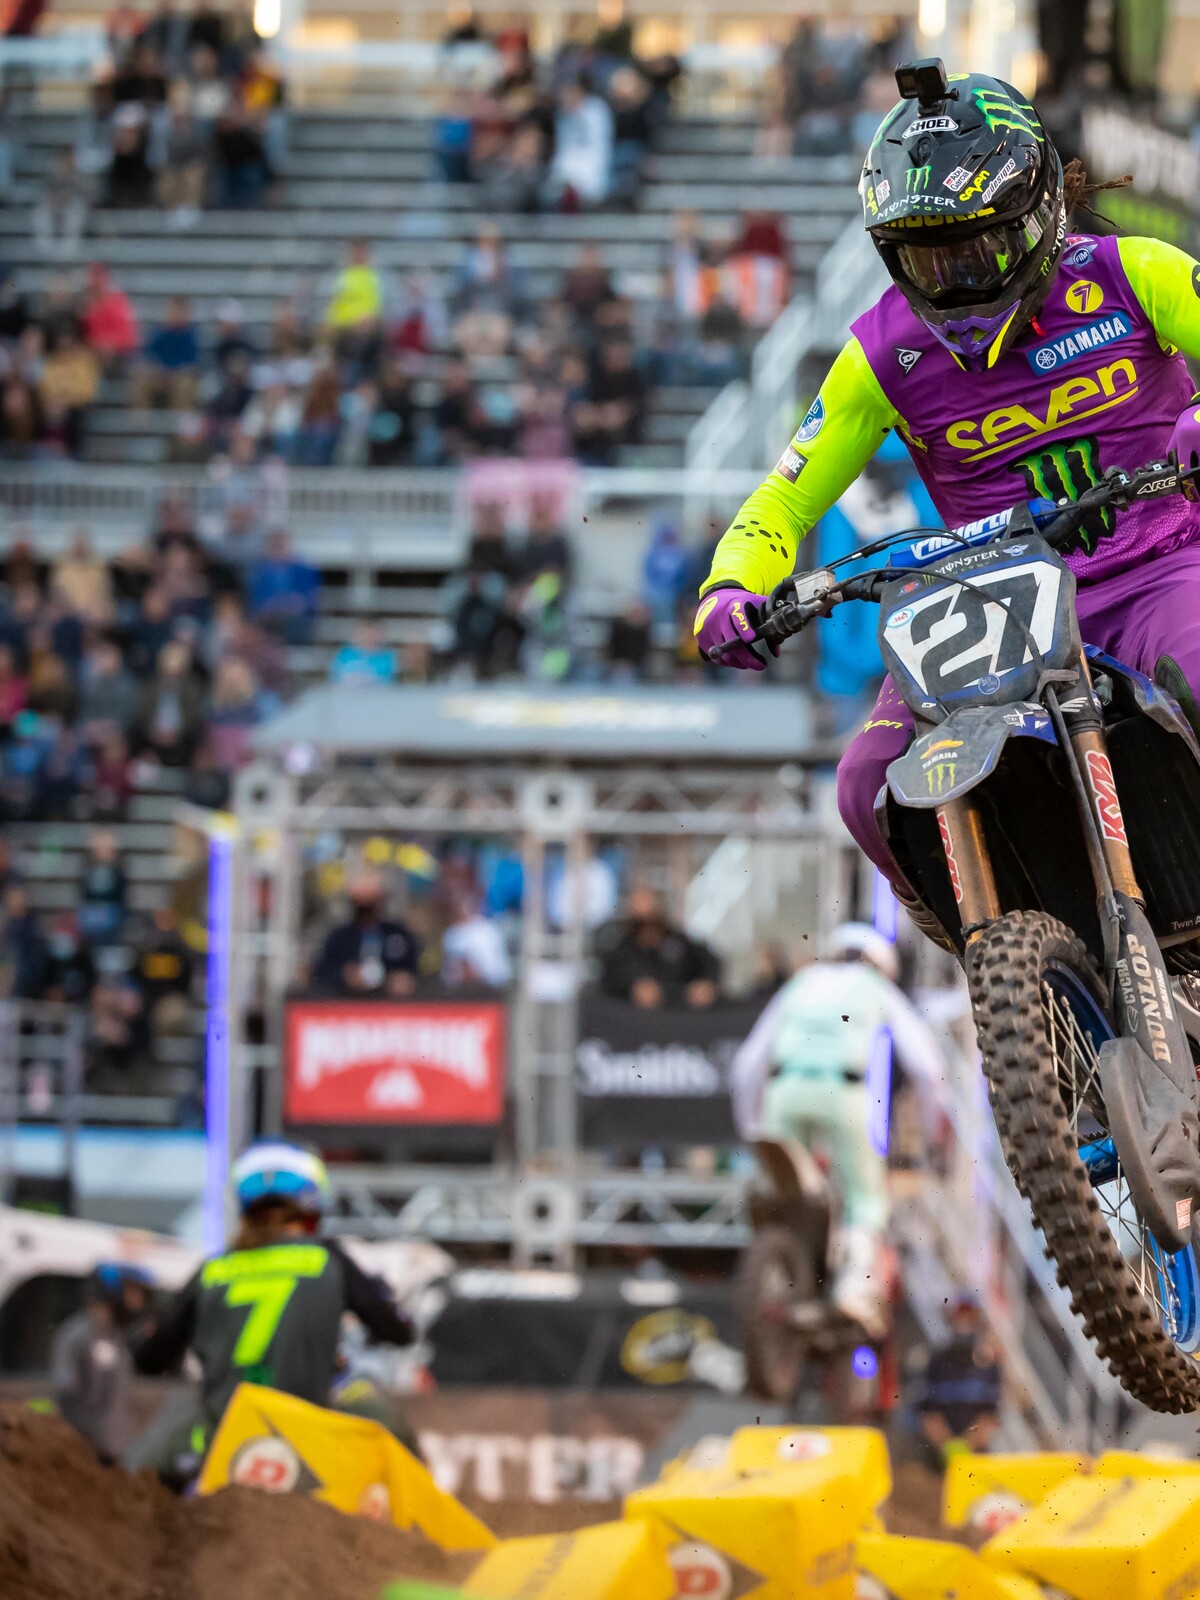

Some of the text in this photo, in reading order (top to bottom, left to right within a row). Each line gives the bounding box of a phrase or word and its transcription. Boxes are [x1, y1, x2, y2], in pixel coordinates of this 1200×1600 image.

[908, 119, 950, 133] SHOEI
[950, 167, 963, 180] Abu
[951, 171, 970, 191] Garcia
[877, 194, 957, 220] MONSTER
[1072, 283, 1092, 312] 7
[1053, 317, 1127, 360] YAMAHA
[1136, 475, 1177, 495] ARC
[935, 550, 999, 574] MONSTER
[911, 573, 1042, 697] 27
[922, 751, 958, 769] YAMAHA
[1171, 919, 1194, 930] Twin
[1117, 957, 1137, 1005] CYCRA
[1126, 932, 1173, 1065] DUNLOP
[226, 1278, 298, 1367] 7
